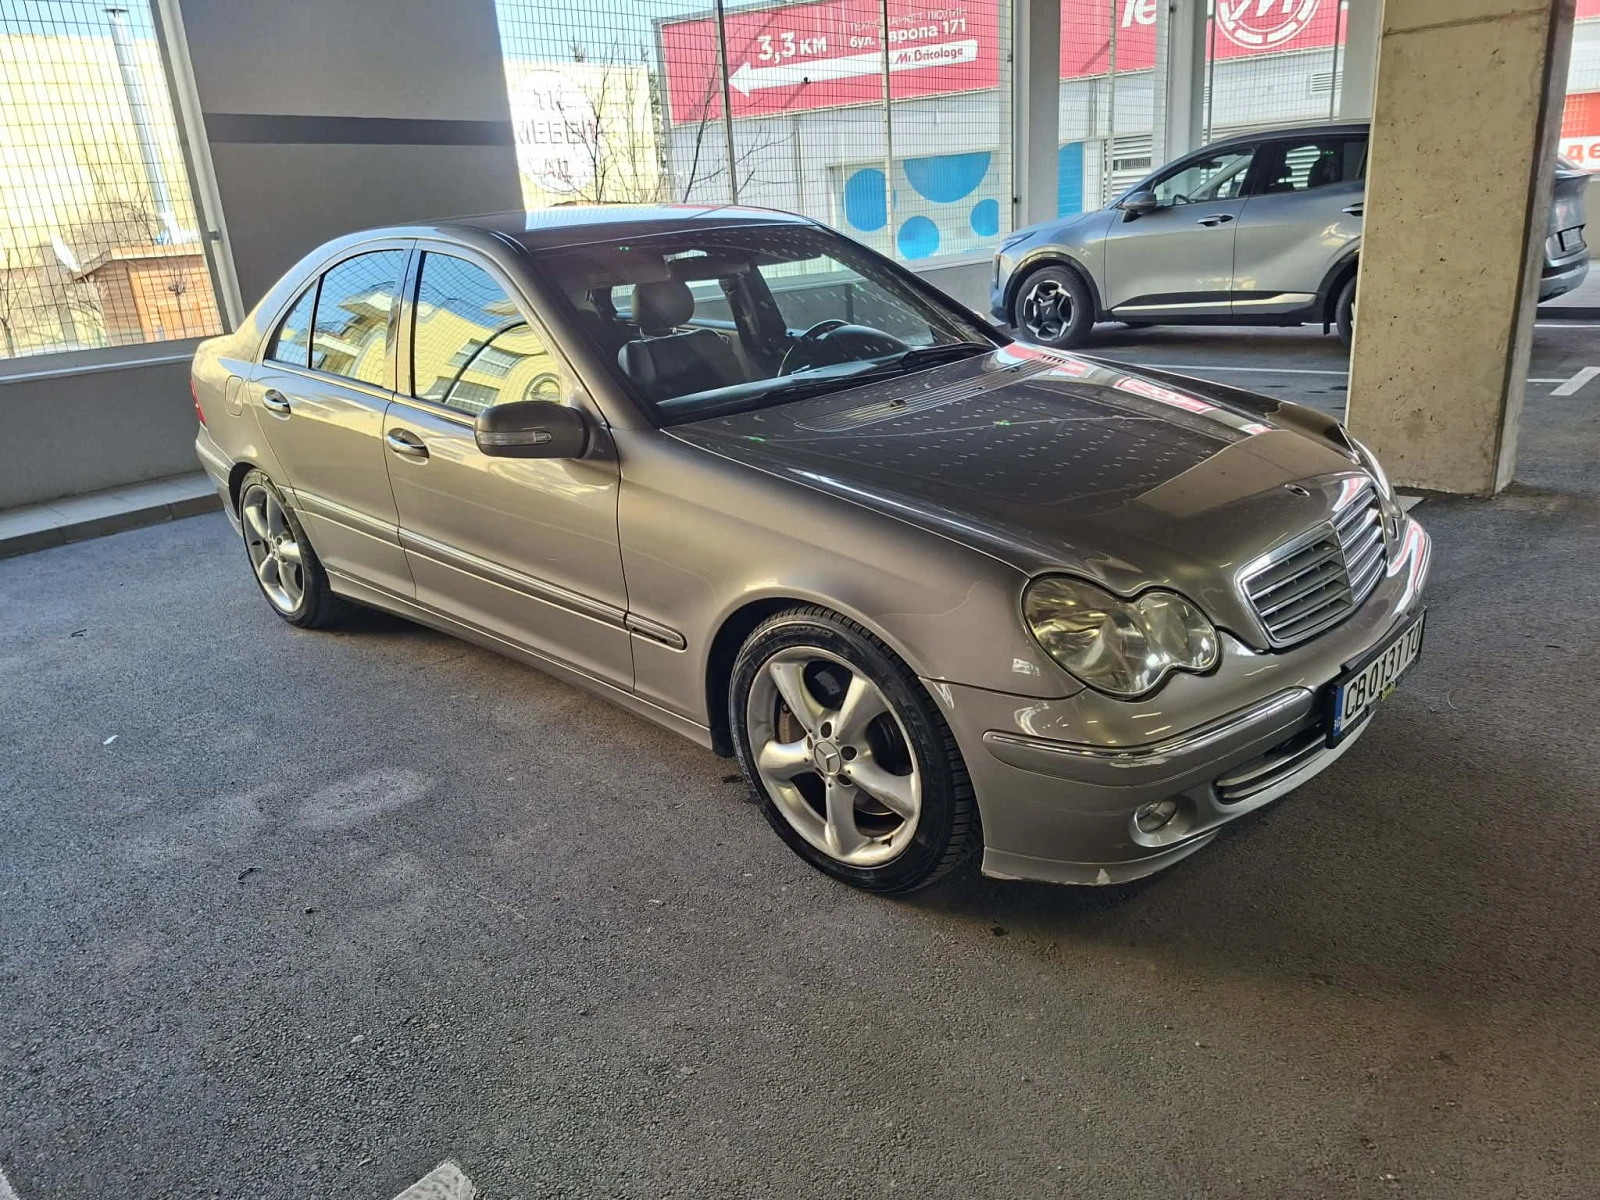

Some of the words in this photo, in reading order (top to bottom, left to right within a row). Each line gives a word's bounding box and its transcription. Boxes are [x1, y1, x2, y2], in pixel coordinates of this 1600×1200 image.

[757, 32, 795, 63] 3,3
[850, 34, 875, 48] бул.
[942, 18, 965, 35] 171
[914, 47, 963, 62] Bricolage
[1344, 673, 1367, 720] CB
